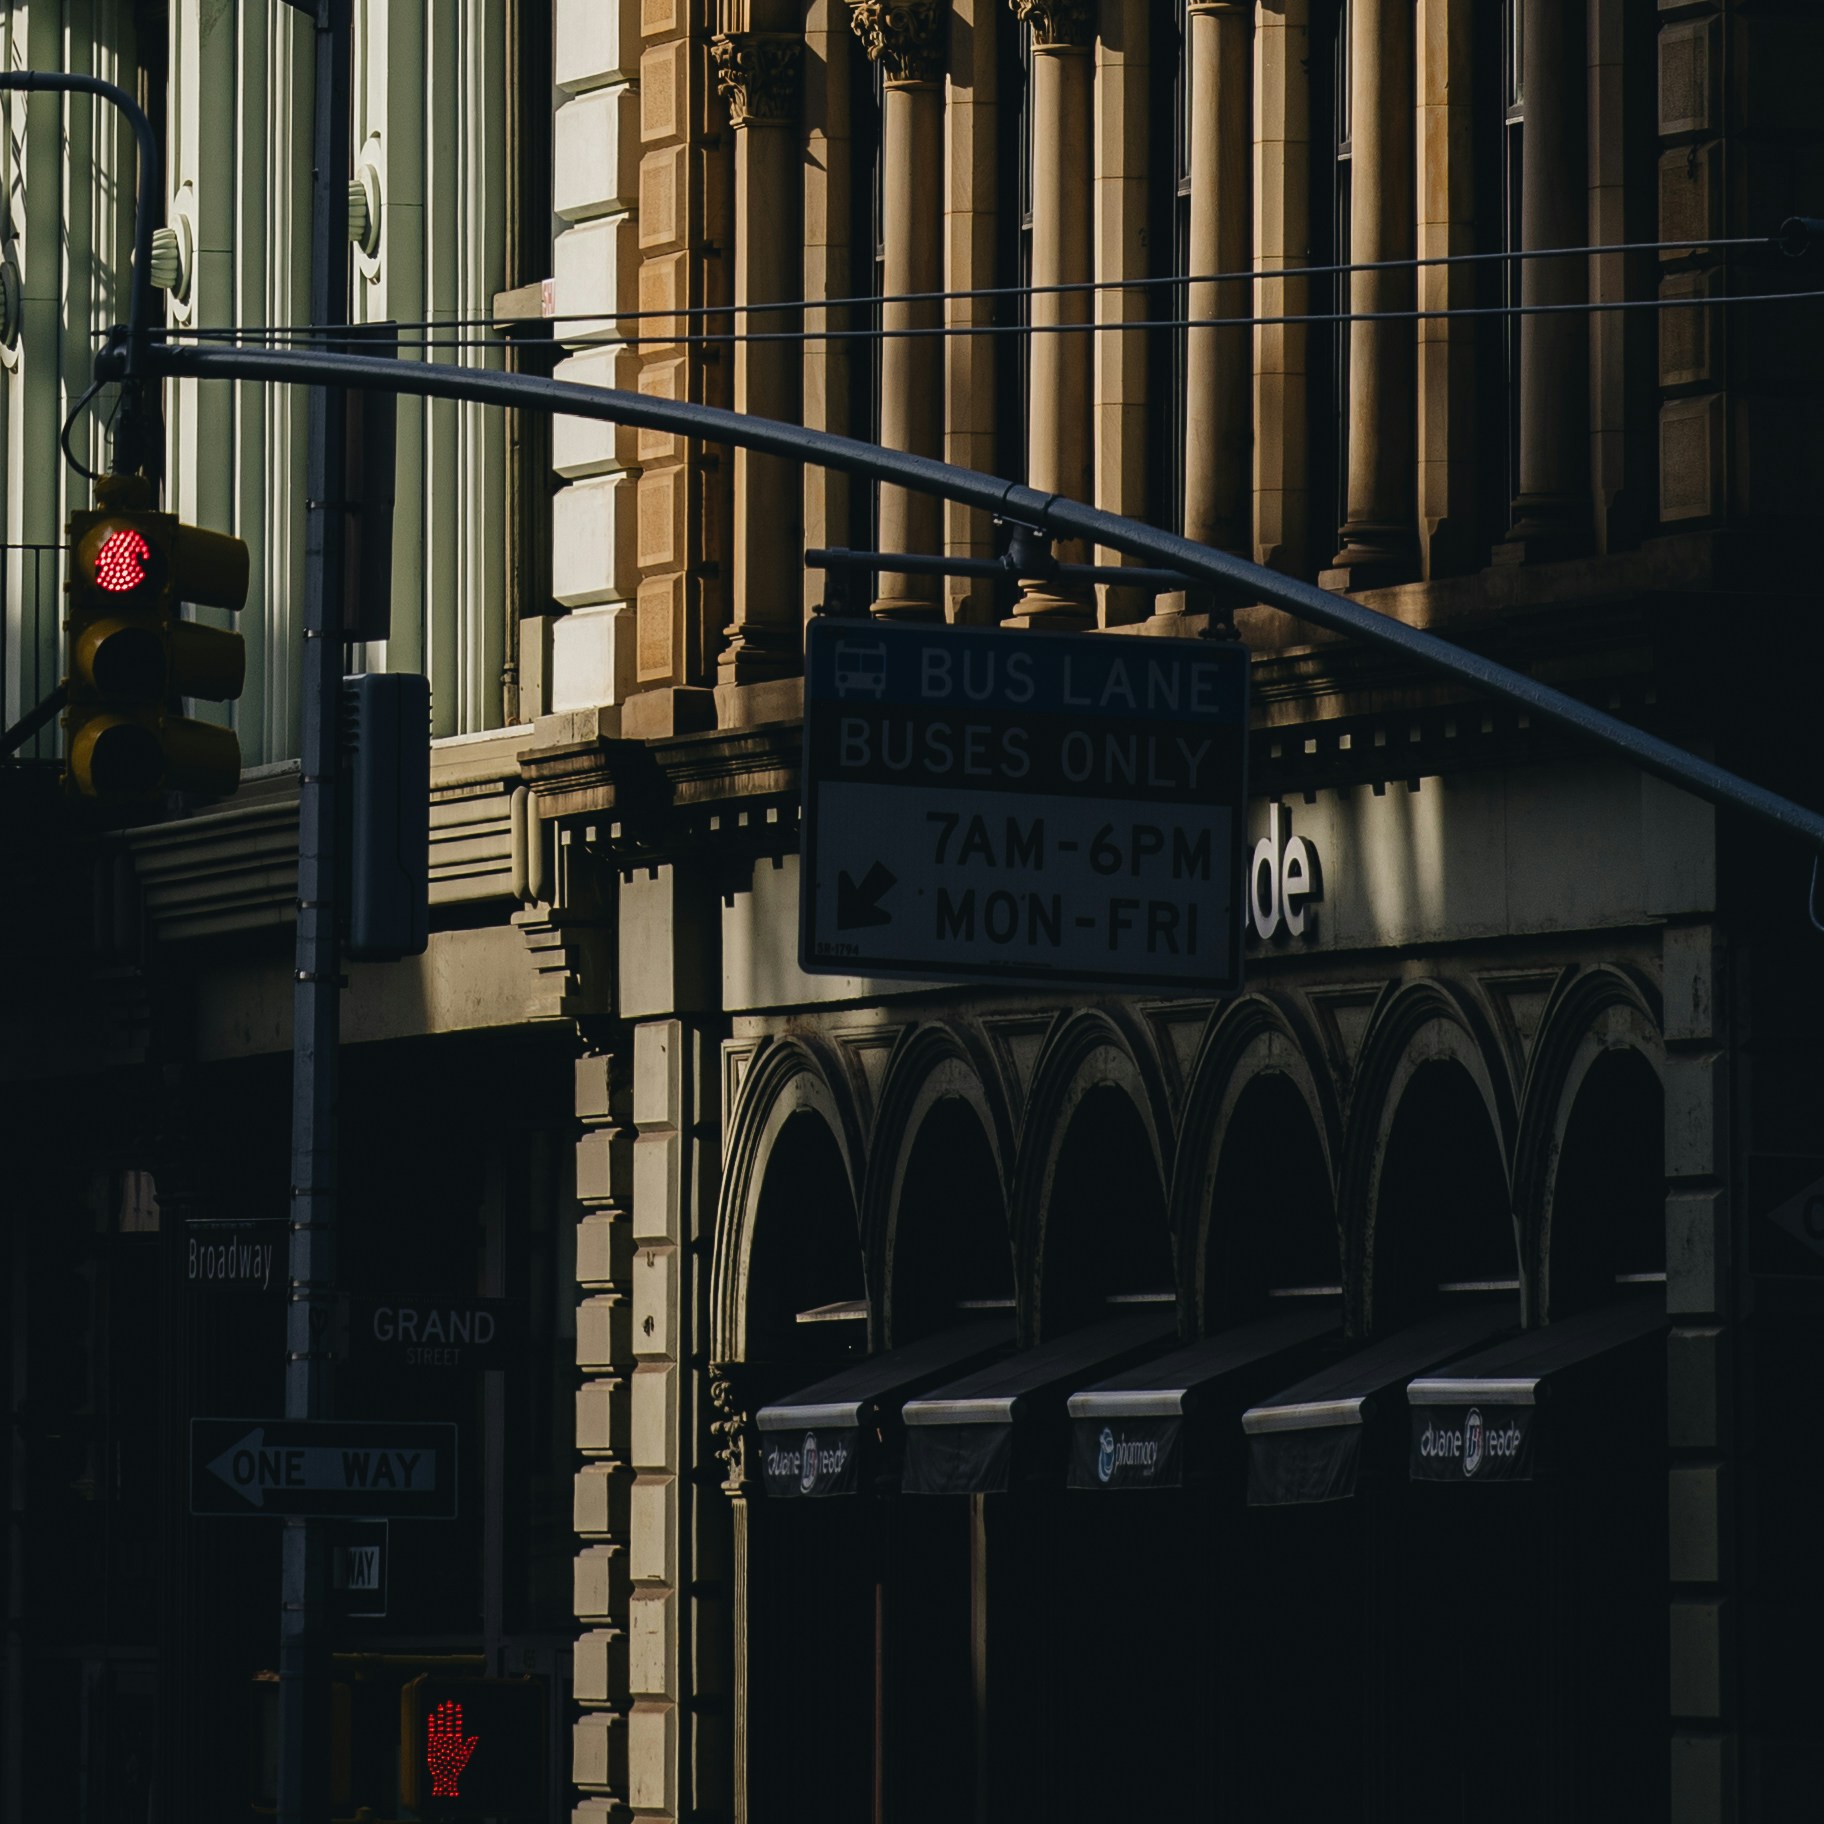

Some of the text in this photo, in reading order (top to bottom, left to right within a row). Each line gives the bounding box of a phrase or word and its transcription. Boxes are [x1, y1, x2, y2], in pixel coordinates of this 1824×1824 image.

[921, 647, 1220, 713] BUS LANE
[839, 717, 1212, 790] BUSES ONLY
[188, 1234, 273, 1291] Broadway
[373, 1307, 496, 1344] GRAND
[406, 1347, 461, 1366] STREET
[1114, 1432, 1158, 1475] pharmacy
[1421, 1417, 1462, 1457] duane
[1485, 1419, 1521, 1457] reade
[233, 1449, 421, 1488] ONE WAY
[767, 1445, 801, 1476] duane
